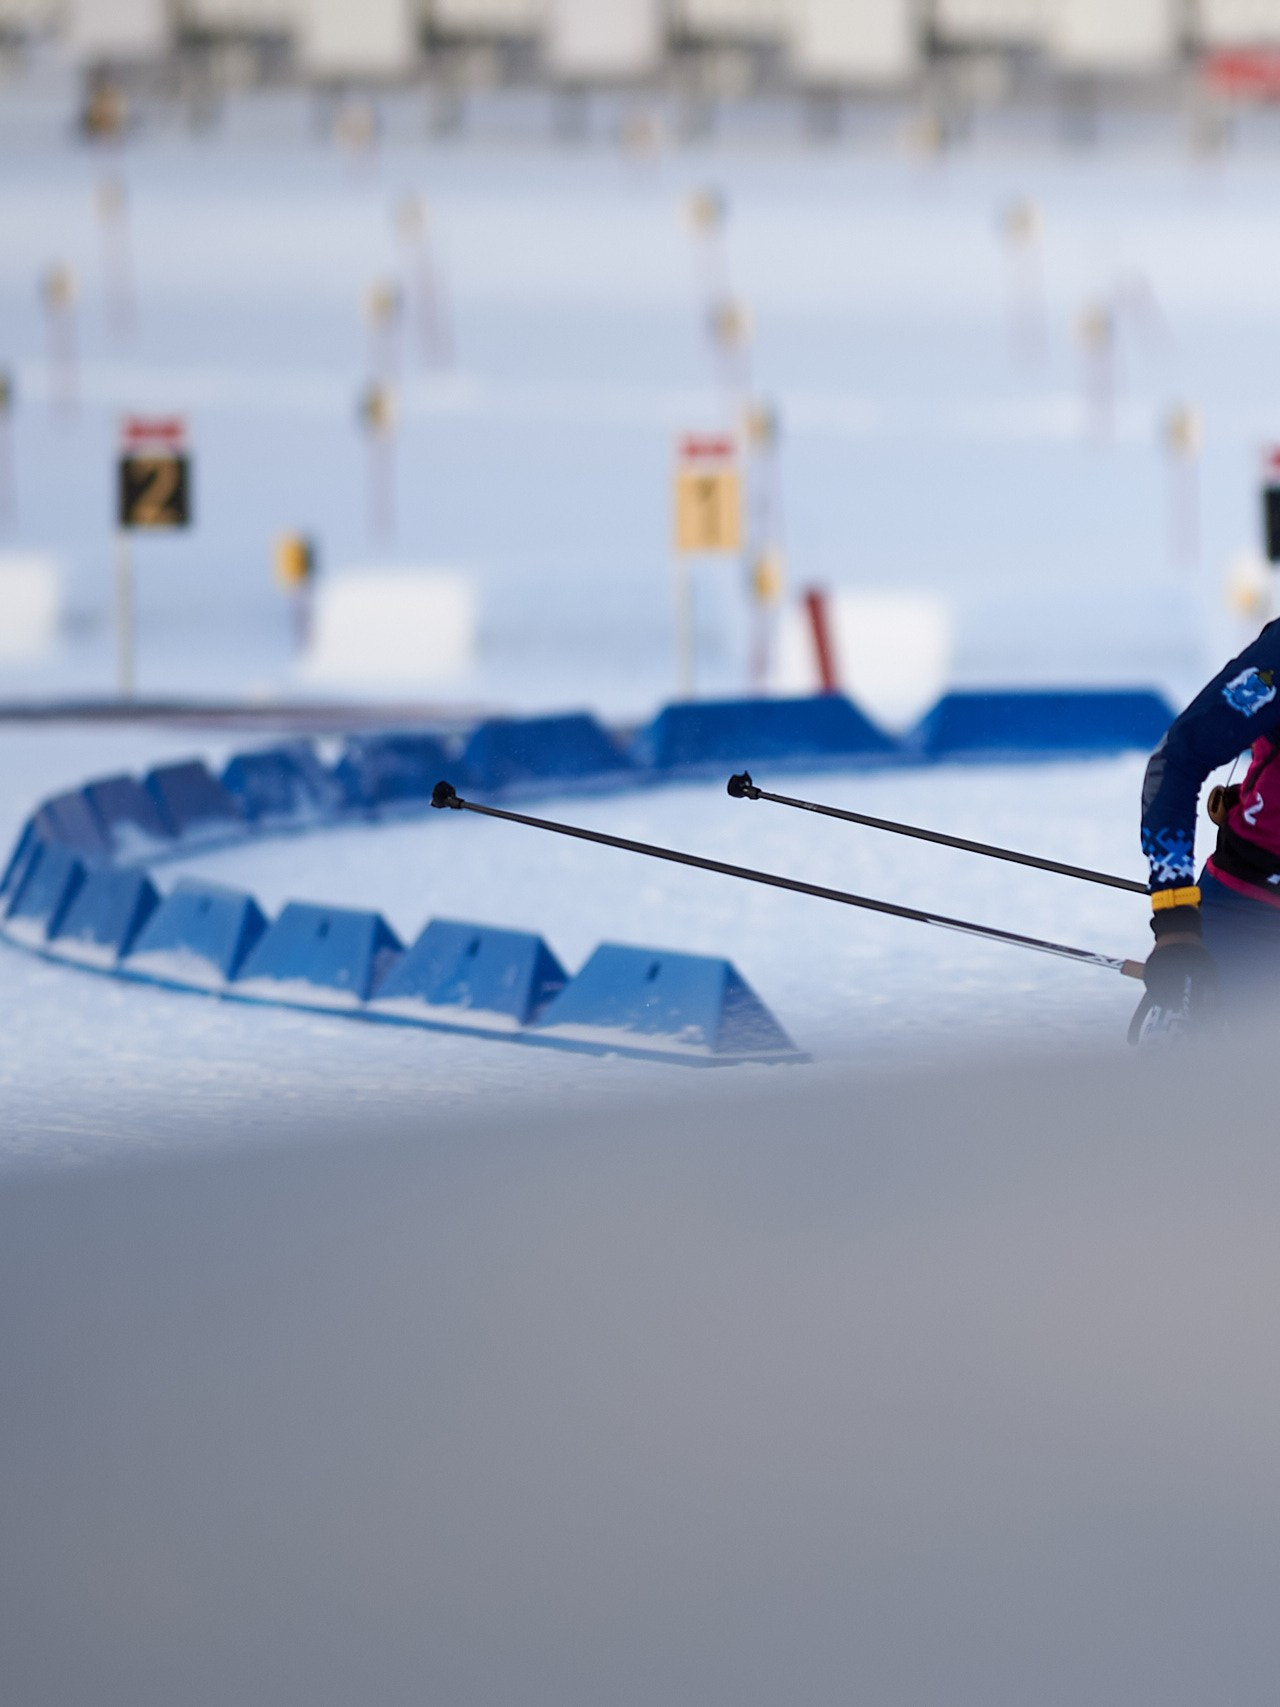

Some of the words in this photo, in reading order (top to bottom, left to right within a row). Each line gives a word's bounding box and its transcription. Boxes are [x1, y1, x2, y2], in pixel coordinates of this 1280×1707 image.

[131, 459, 181, 524] 2
[694, 479, 720, 545] 1
[1243, 792, 1264, 826] 2
